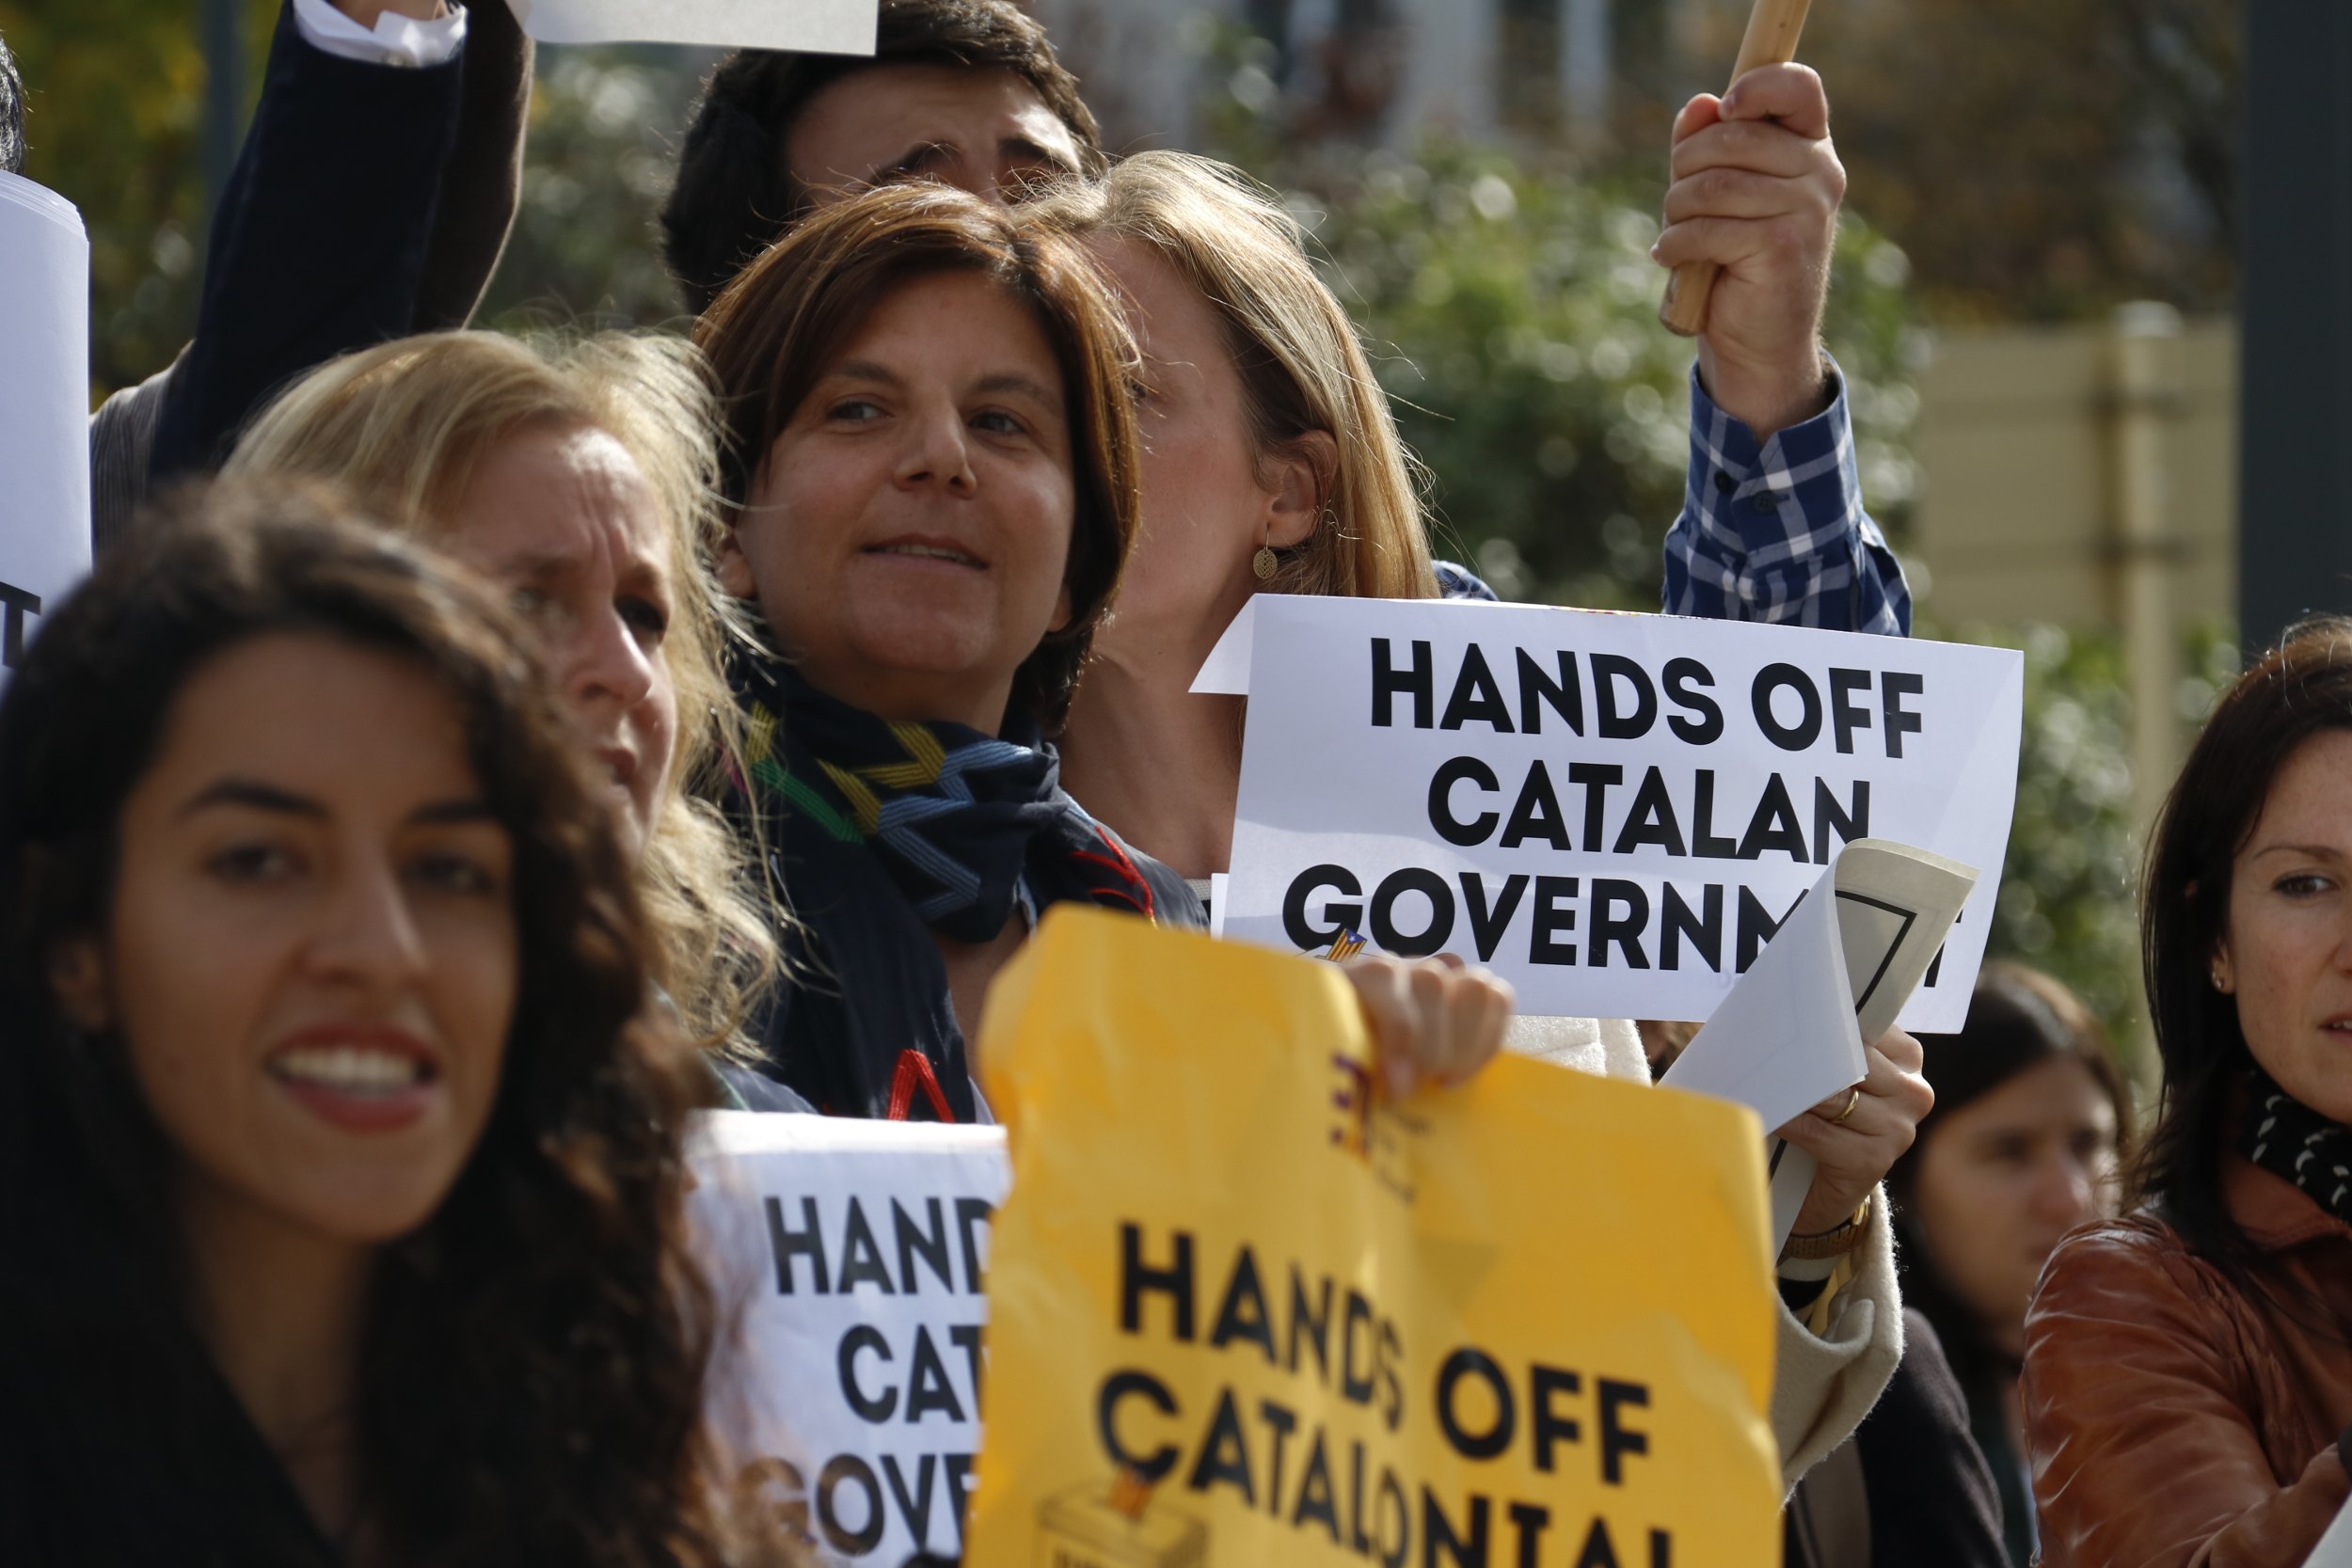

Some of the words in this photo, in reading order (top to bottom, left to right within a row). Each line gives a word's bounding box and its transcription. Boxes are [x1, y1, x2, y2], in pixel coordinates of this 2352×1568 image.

[1370, 638, 1724, 746] HANDS
[1751, 662, 1924, 759] OFF
[1427, 755, 1871, 865] CATALAN
[1117, 1220, 1404, 1433] HANDS
[1435, 1345, 1652, 1486] OFF
